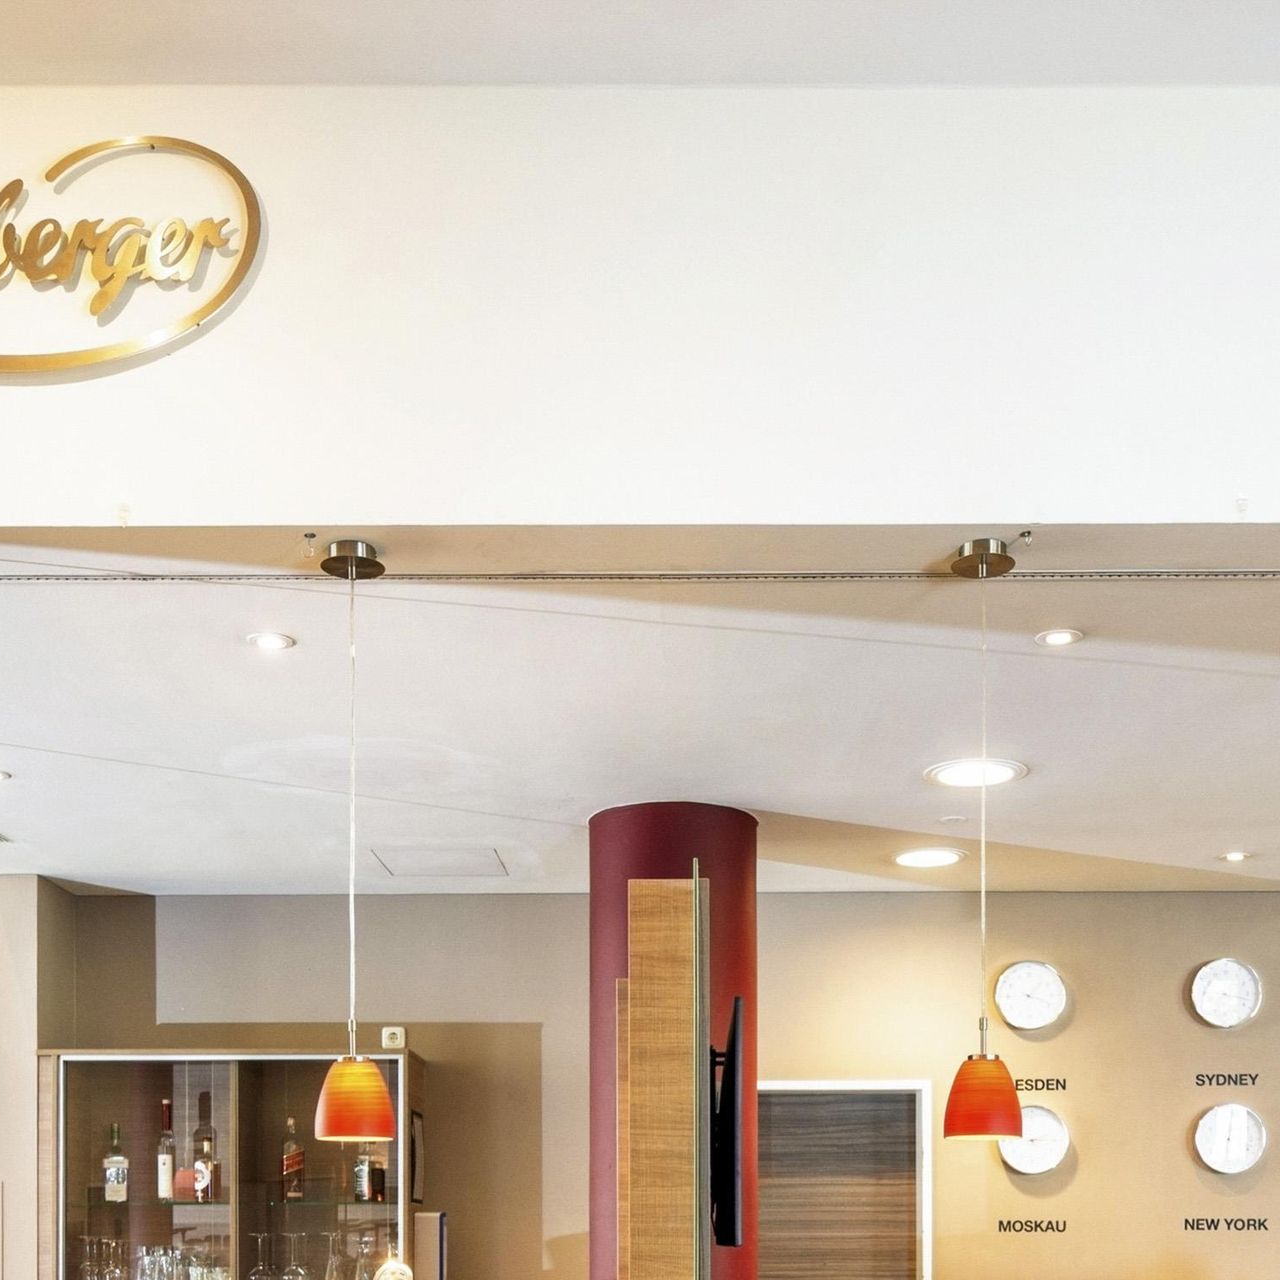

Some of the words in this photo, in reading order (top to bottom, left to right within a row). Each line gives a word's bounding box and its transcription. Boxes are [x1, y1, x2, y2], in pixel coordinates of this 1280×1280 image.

[1015, 1078, 1067, 1091] ESDEN
[1195, 1073, 1259, 1086] SYDNEY
[998, 1219, 1067, 1233] MOSKAU
[1184, 1218, 1221, 1231] NEW
[1223, 1217, 1269, 1231] YORK
